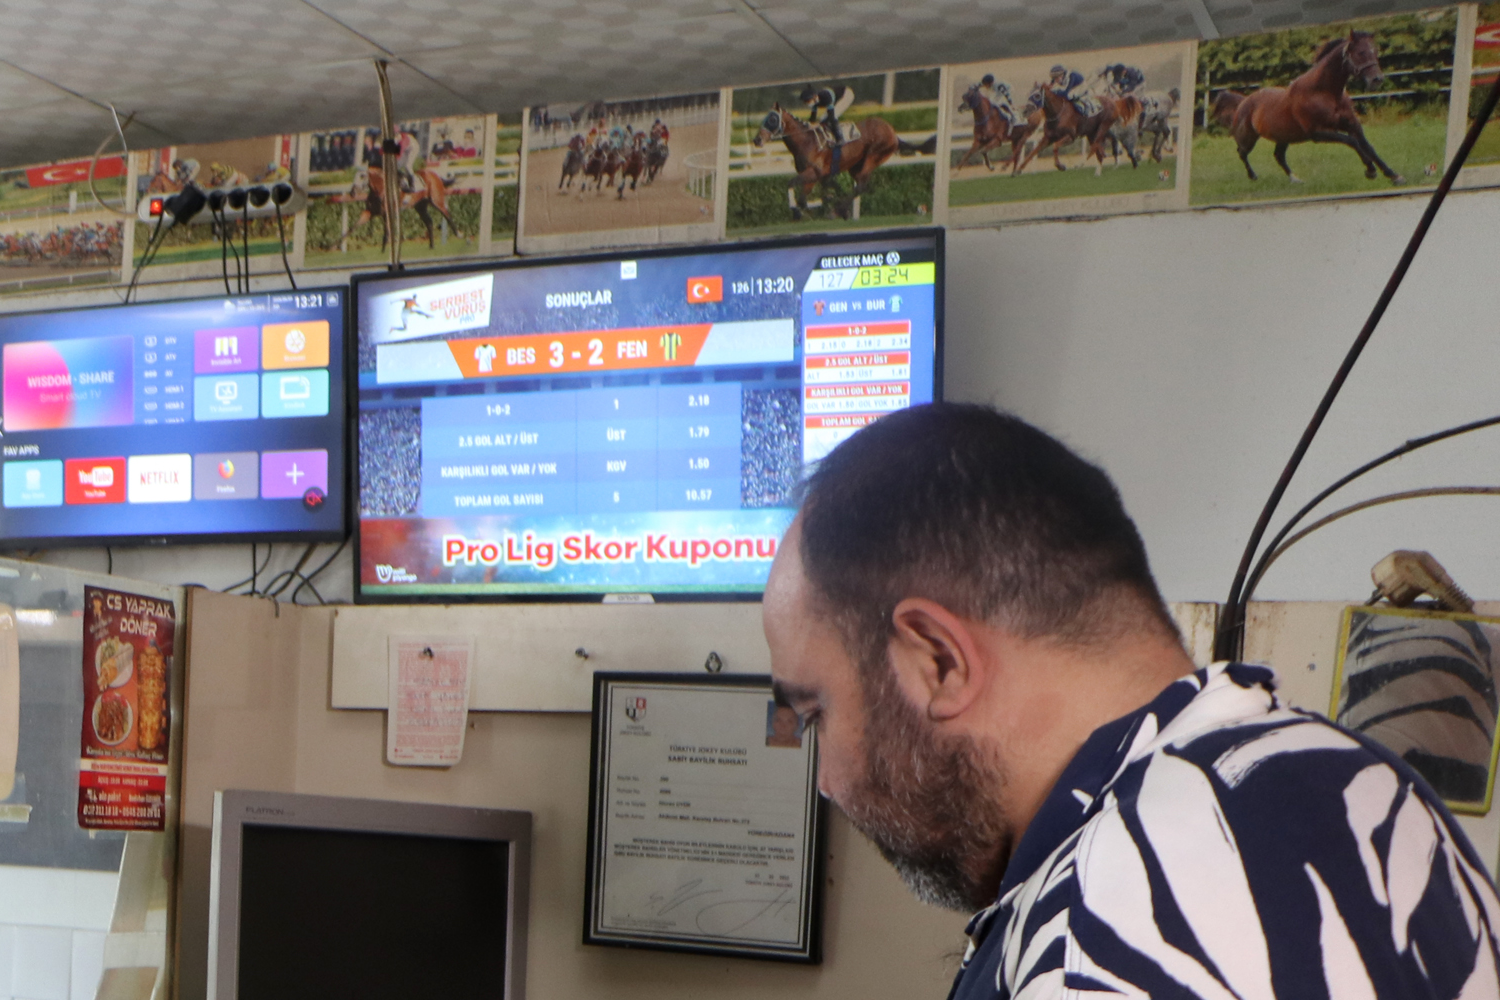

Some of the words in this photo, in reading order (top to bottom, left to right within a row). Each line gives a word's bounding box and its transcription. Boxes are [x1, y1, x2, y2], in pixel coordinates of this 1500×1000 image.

[821, 256, 860, 269] GELECEK
[862, 254, 884, 268] MAÇ
[732, 281, 749, 294] 126
[757, 276, 794, 294] 13:20
[819, 272, 844, 288] 127
[861, 268, 909, 285] 03:24
[294, 295, 322, 309] 13:21
[430, 289, 484, 312] SERBEST
[546, 290, 612, 309] SONUÇLAR
[829, 302, 847, 313] GEN
[866, 299, 886, 311] BUR
[507, 347, 536, 365] BES
[549, 341, 564, 368] 3
[588, 338, 604, 366] 2
[617, 340, 648, 359] FEN
[853, 355, 867, 365] ALT
[27, 375, 71, 388] WISDOM
[79, 371, 115, 384] SHARE
[811, 386, 850, 398] KARŞILIKLI
[851, 386, 865, 396] GOL
[866, 385, 881, 395] VAR
[888, 384, 903, 394] YOK
[821, 416, 852, 427] TOPLAM
[852, 415, 866, 426] GOL
[459, 436, 473, 447] 2.5
[475, 435, 493, 447] GOL
[494, 434, 512, 445] ALT
[520, 431, 539, 445] ÜST
[607, 427, 626, 441] ÜST
[3, 445, 18, 456] FAV
[19, 444, 40, 456] APPS
[78, 466, 113, 485] YouTube
[140, 472, 179, 485] NETFLIX
[441, 466, 489, 479] KARŞILIKLI
[491, 464, 509, 476] GOL
[511, 463, 530, 475] VAR
[538, 463, 557, 475] YOK
[454, 495, 492, 507] TOPLAM
[494, 494, 511, 506] GOL
[513, 493, 544, 505] SAYISI
[445, 539, 499, 562] Pro
[506, 536, 553, 566] Lig
[563, 535, 638, 559] Skor
[646, 533, 776, 565] Kuponu
[107, 594, 122, 610] CS
[125, 597, 172, 619] YAPRAK
[120, 614, 158, 637] DÖNER
